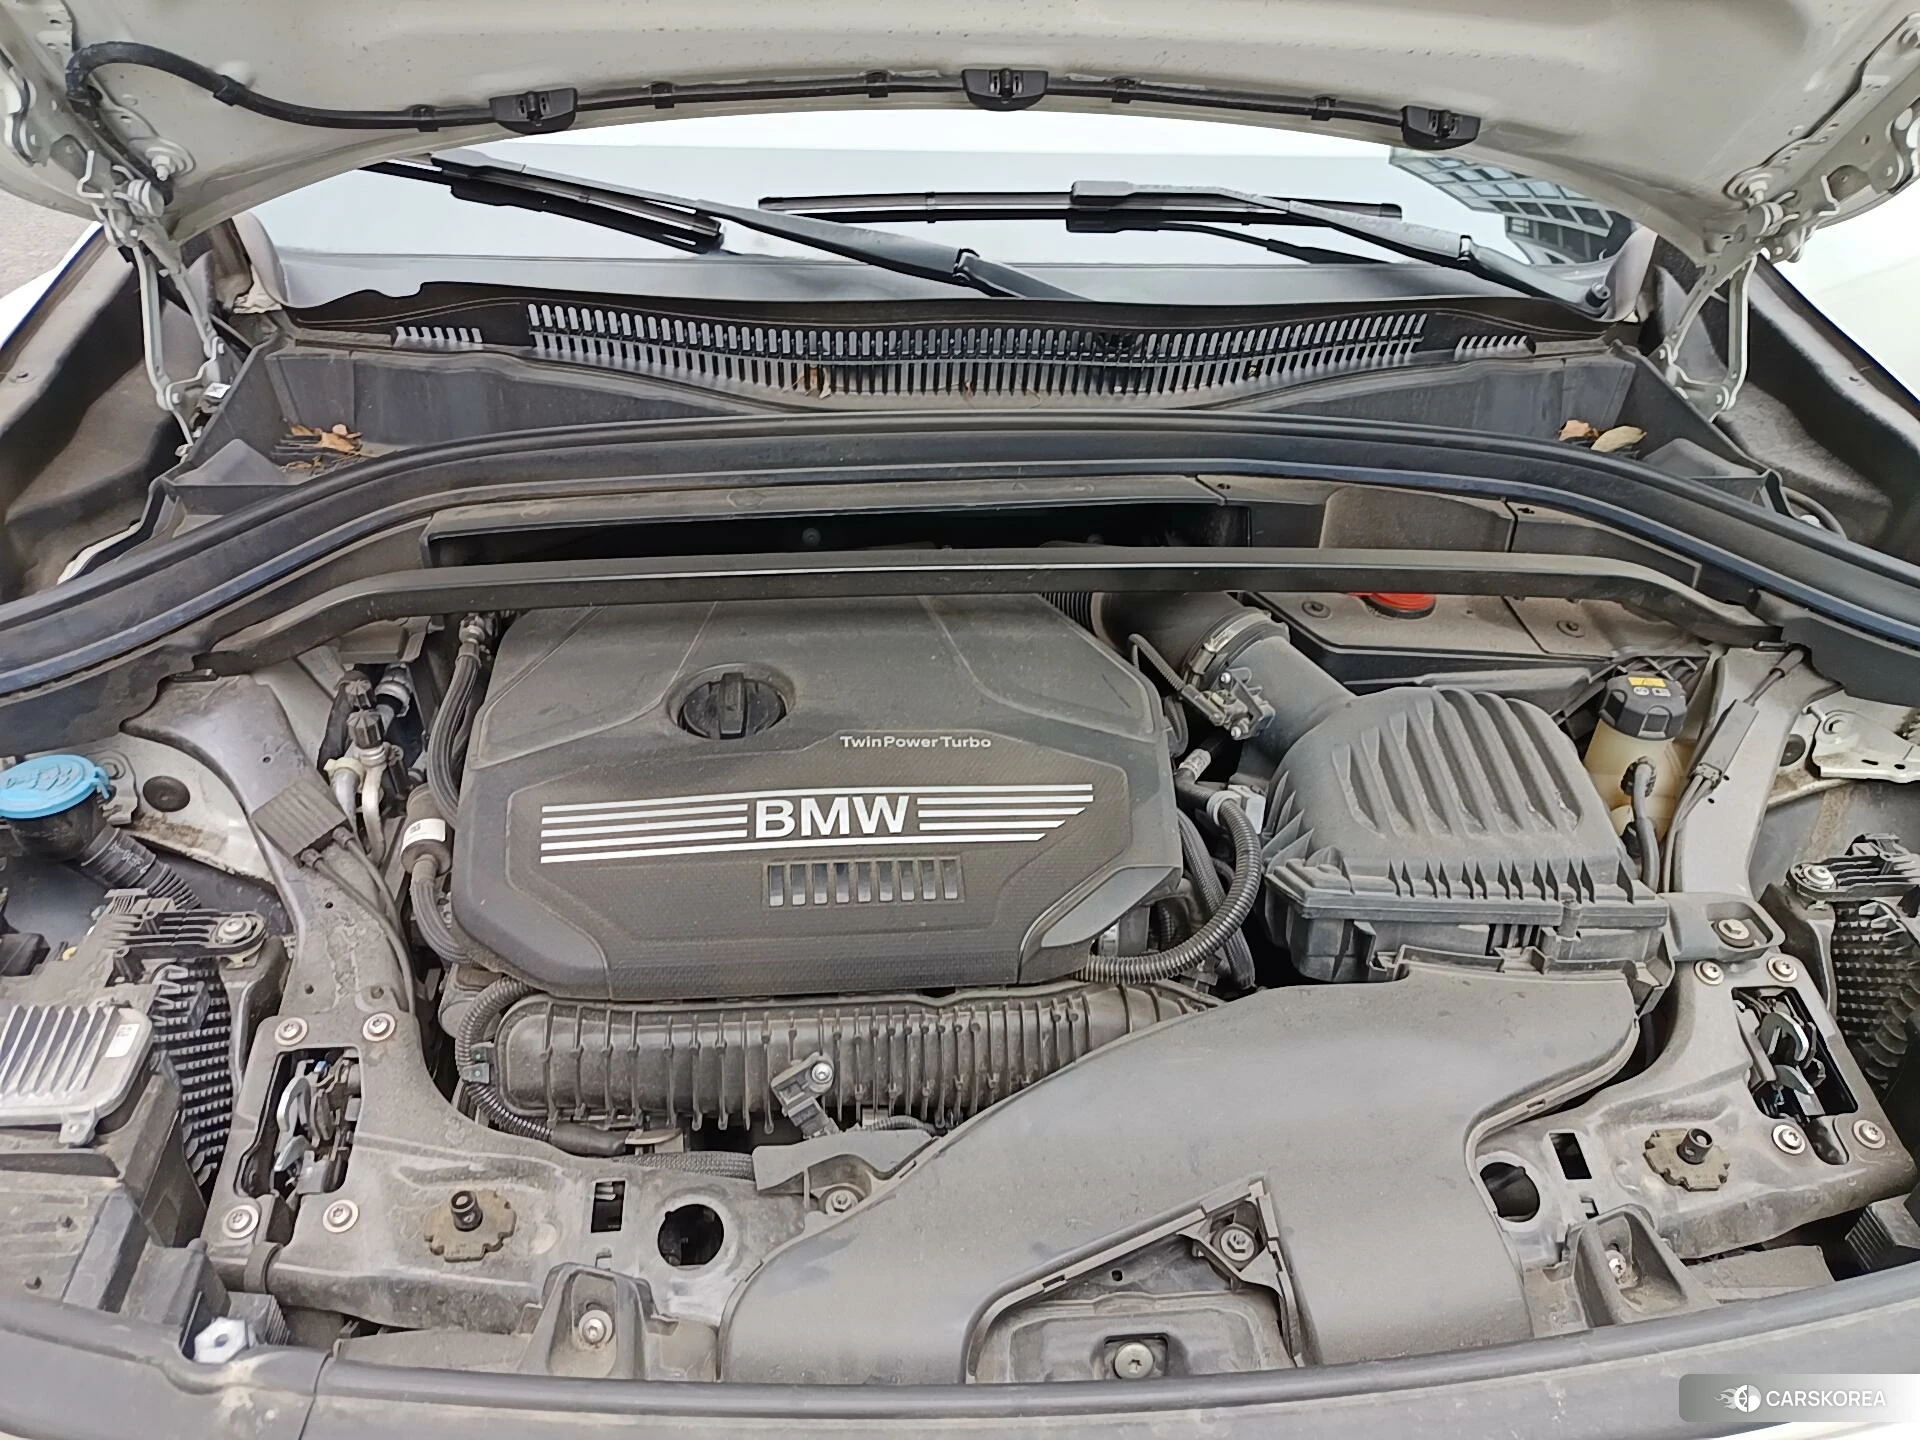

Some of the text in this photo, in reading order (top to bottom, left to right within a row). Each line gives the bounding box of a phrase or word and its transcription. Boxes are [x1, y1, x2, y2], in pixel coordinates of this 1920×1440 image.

[840, 735, 992, 748] TwinPower Turbo
[755, 795, 910, 838] BMW
